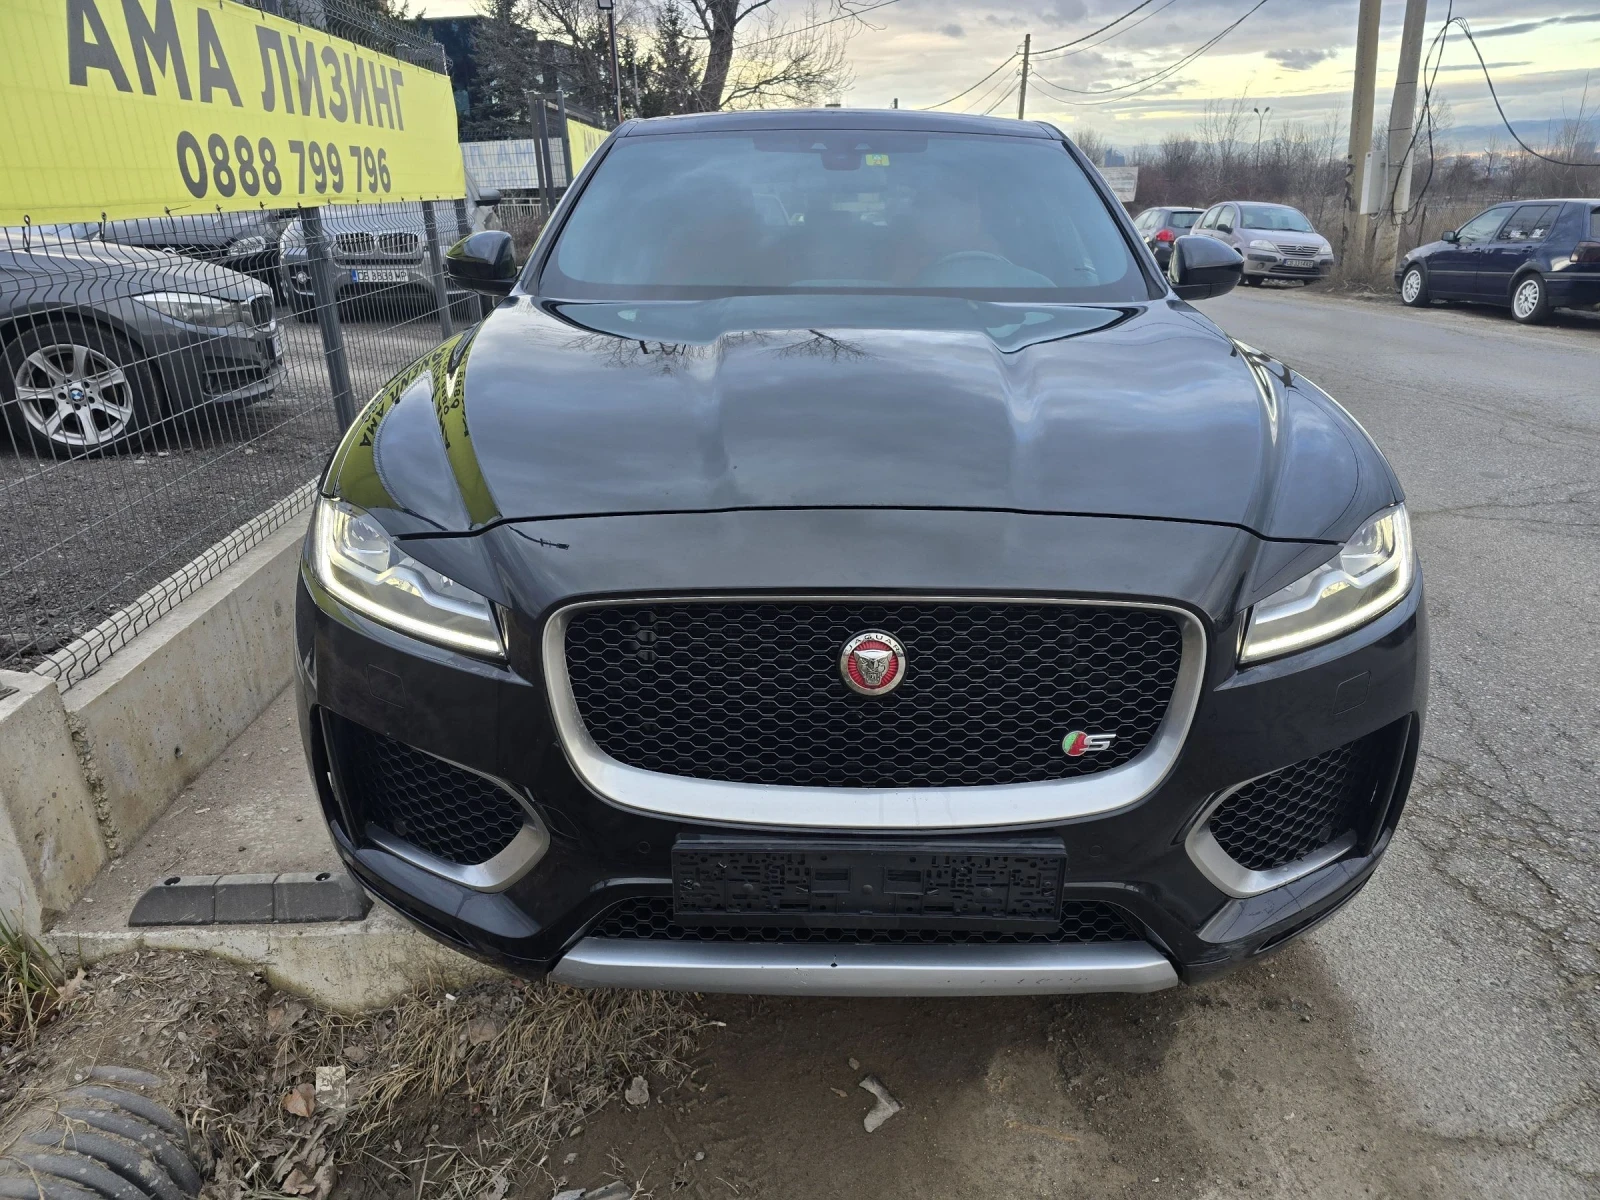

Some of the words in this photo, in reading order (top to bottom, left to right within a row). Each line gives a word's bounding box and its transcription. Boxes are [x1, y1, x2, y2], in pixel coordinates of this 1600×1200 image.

[66, 0, 244, 108] АМА
[255, 25, 405, 131] ЛИЗИНГ
[176, 130, 282, 198] 0888
[288, 139, 344, 194] 799
[350, 145, 391, 193] 796
[849, 634, 900, 651] JAGUAR
